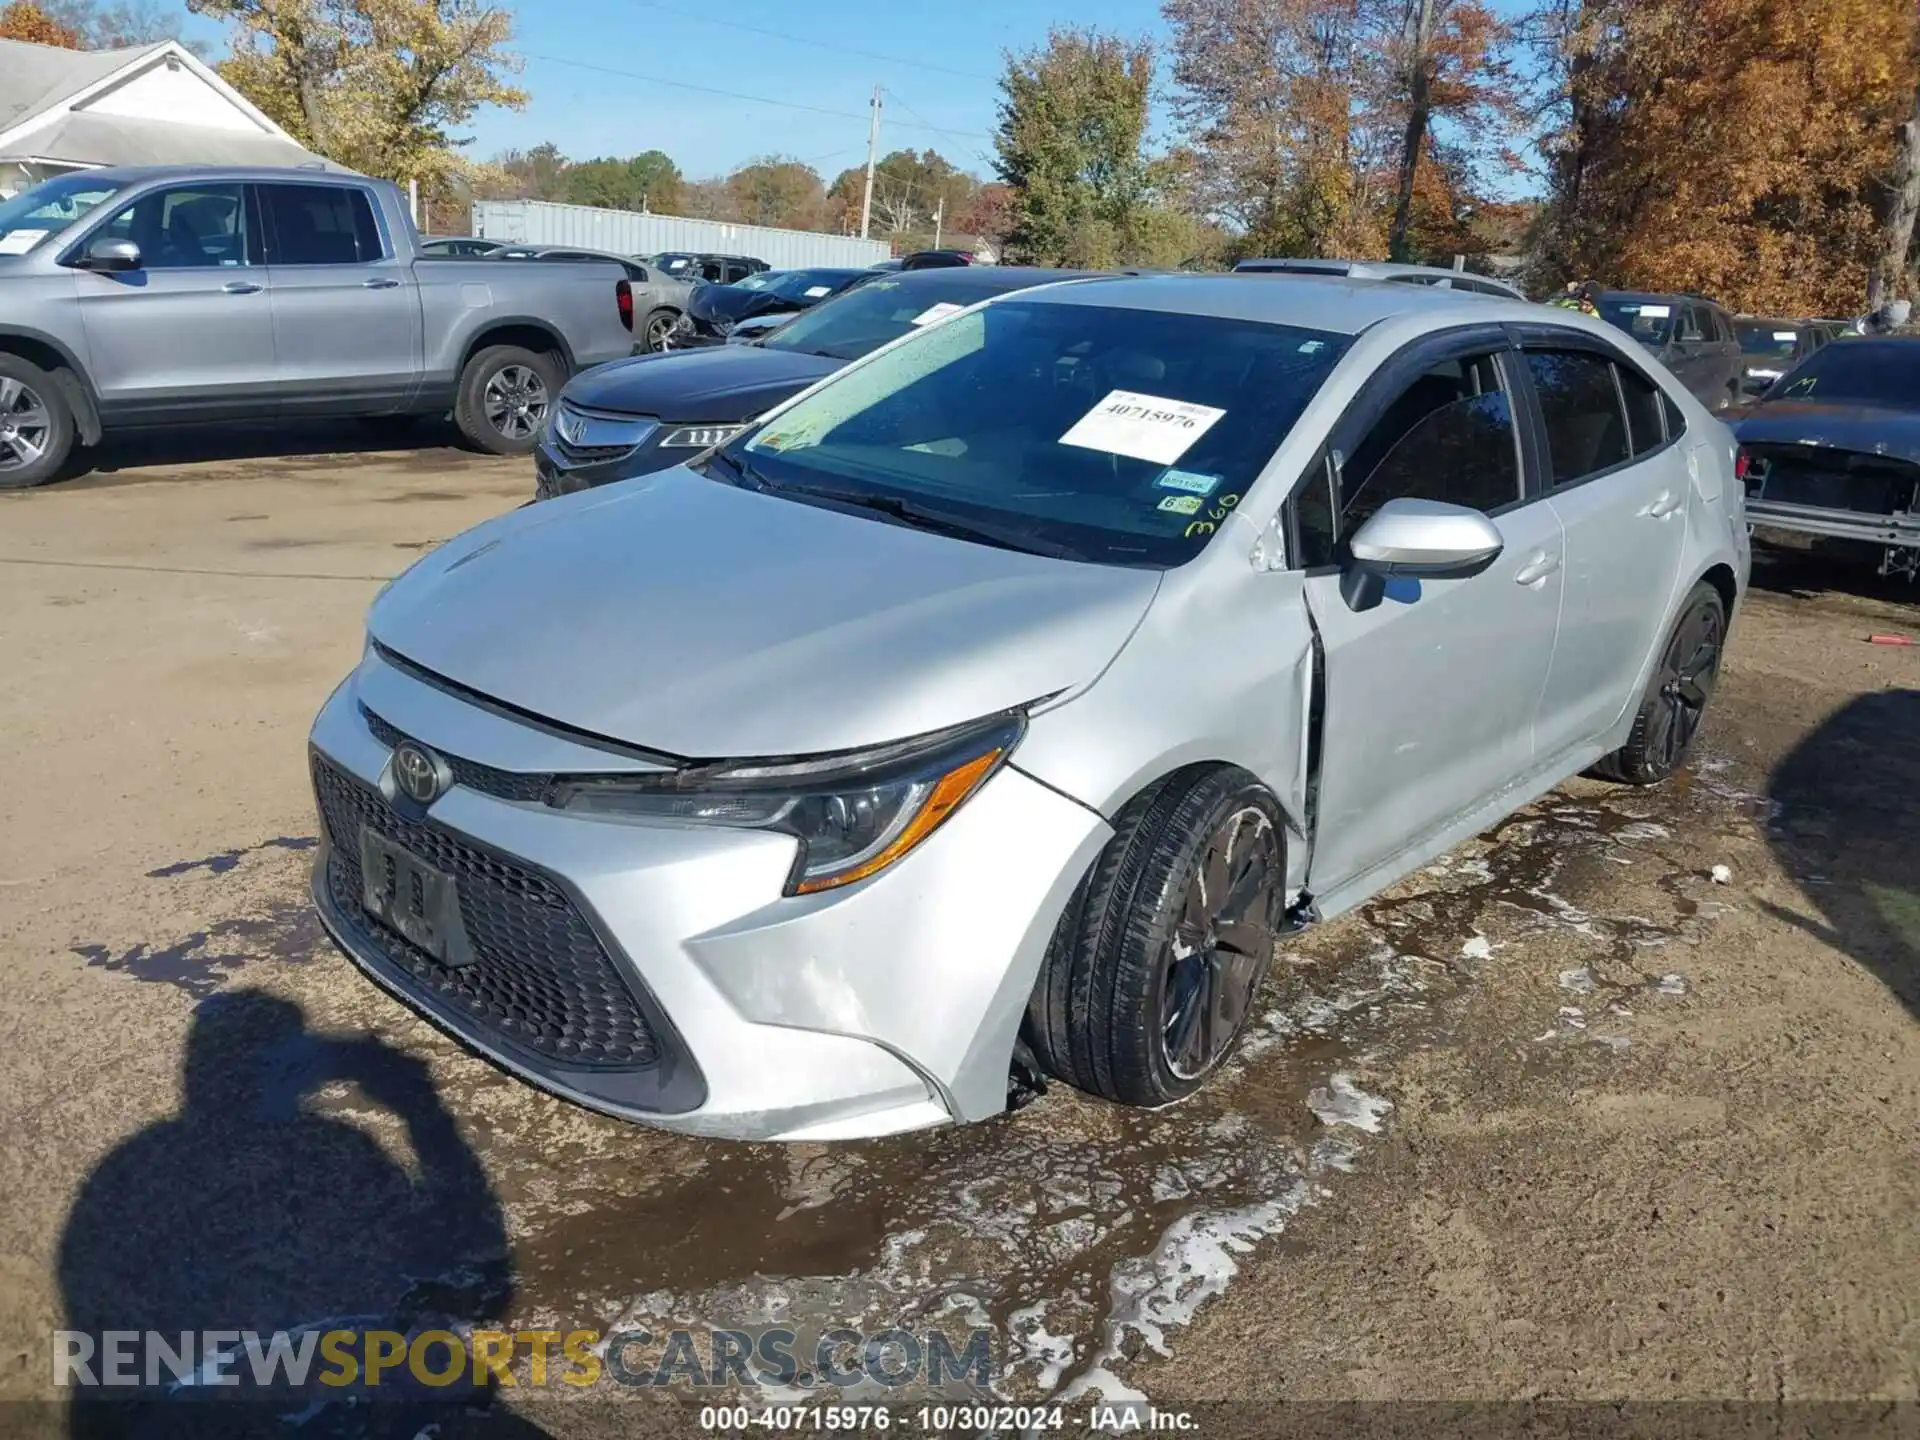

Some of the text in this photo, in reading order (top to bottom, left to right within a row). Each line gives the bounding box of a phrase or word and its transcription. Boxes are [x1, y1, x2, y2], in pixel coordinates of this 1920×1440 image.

[1106, 404, 1195, 428] 40715976
[1164, 498, 1177, 508] 6
[1184, 494, 1239, 538] 360
